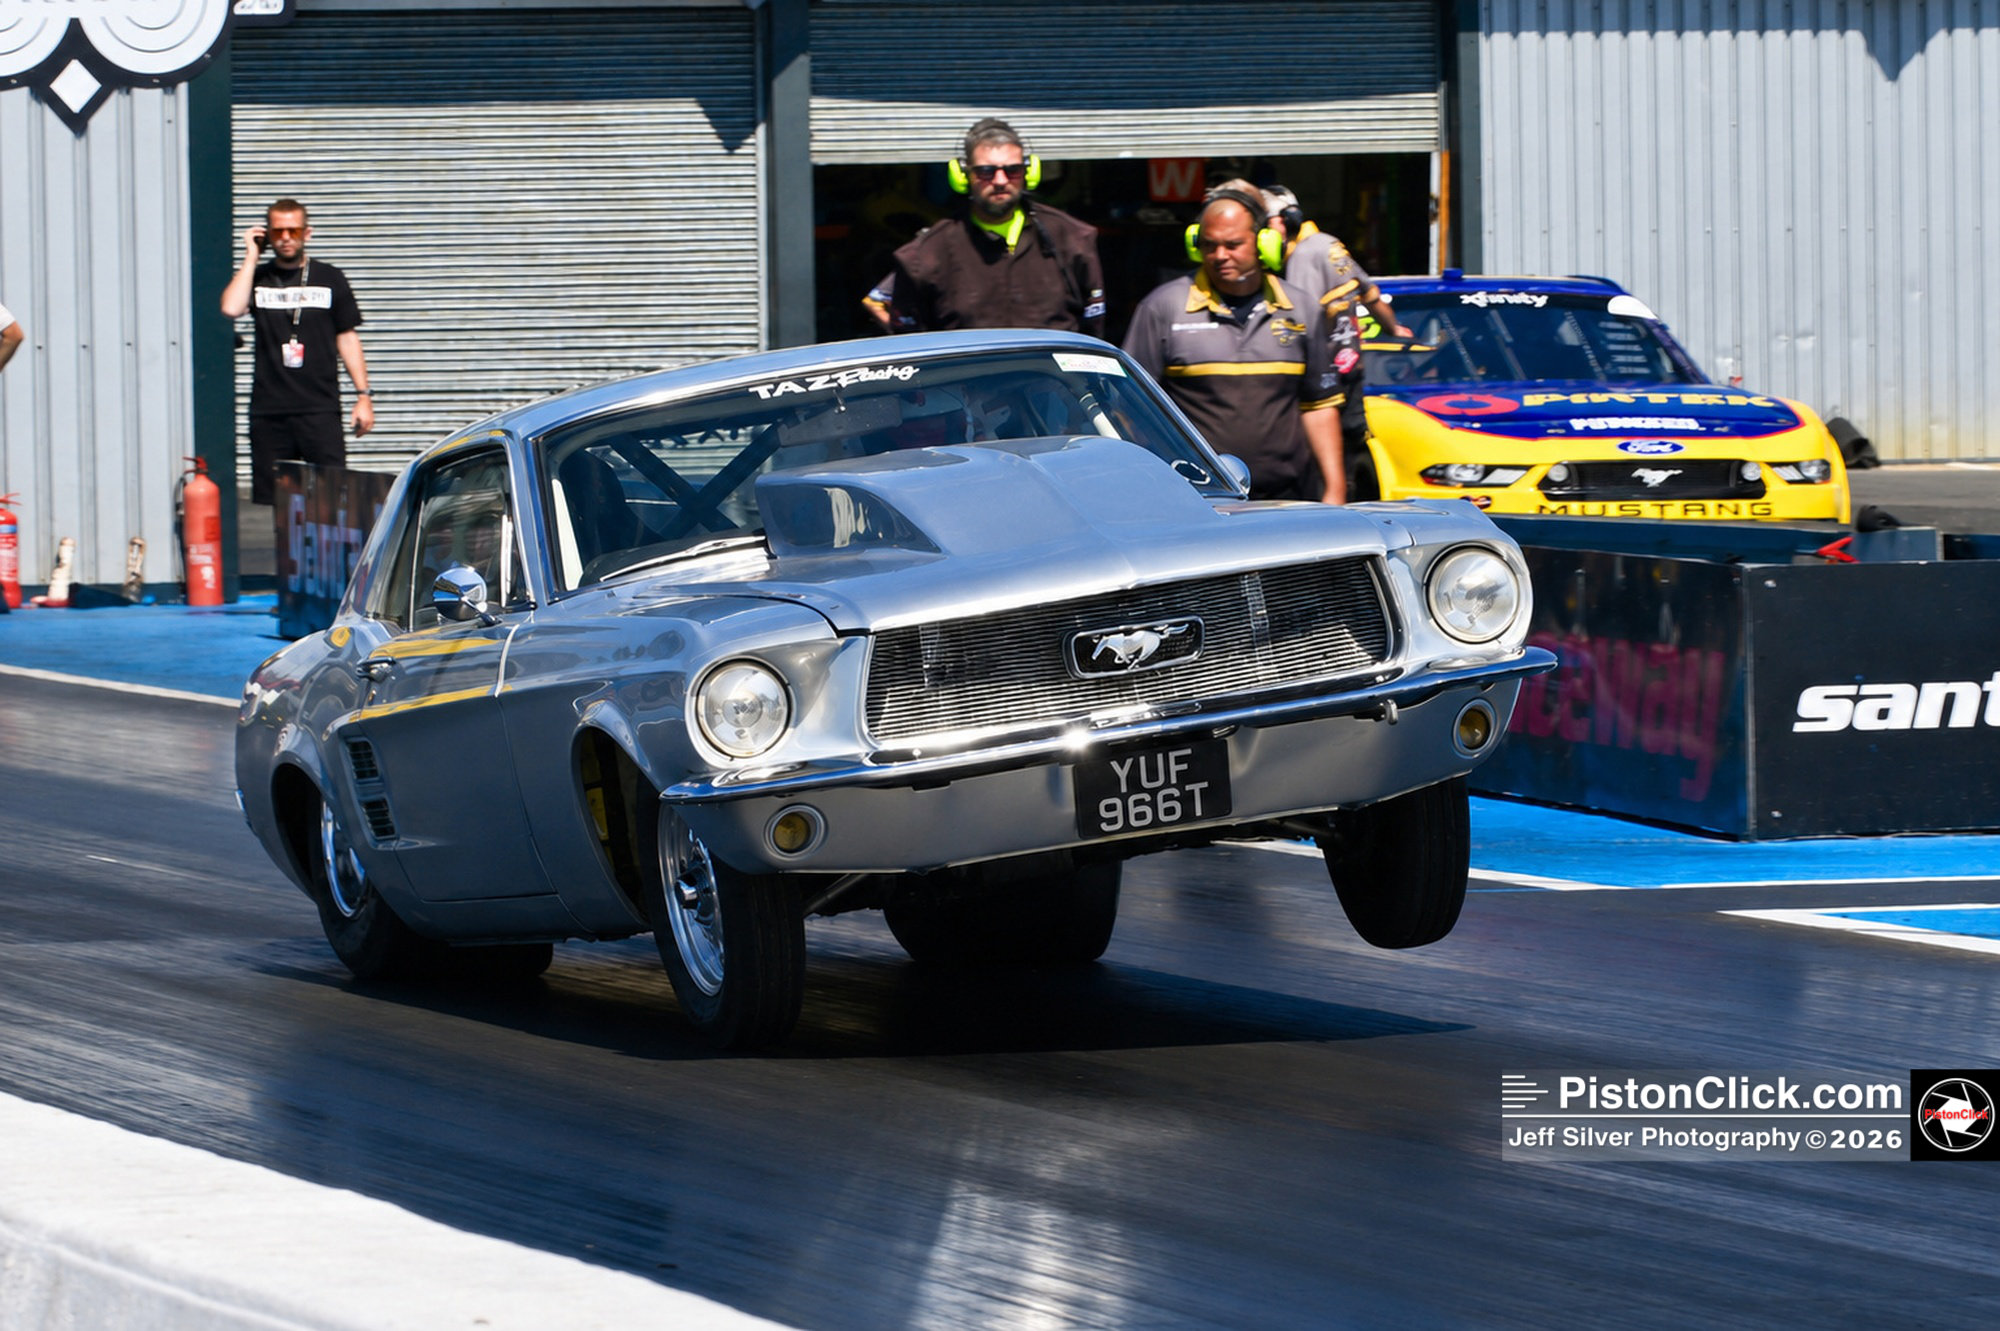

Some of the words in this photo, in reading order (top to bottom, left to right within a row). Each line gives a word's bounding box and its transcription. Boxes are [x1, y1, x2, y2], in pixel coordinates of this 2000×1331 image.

[748, 375, 837, 400] TAZ
[832, 365, 920, 388] Racing
[1538, 502, 1772, 517] MUSTANG
[1110, 748, 1192, 793] YUF
[1099, 781, 1209, 832] 966T
